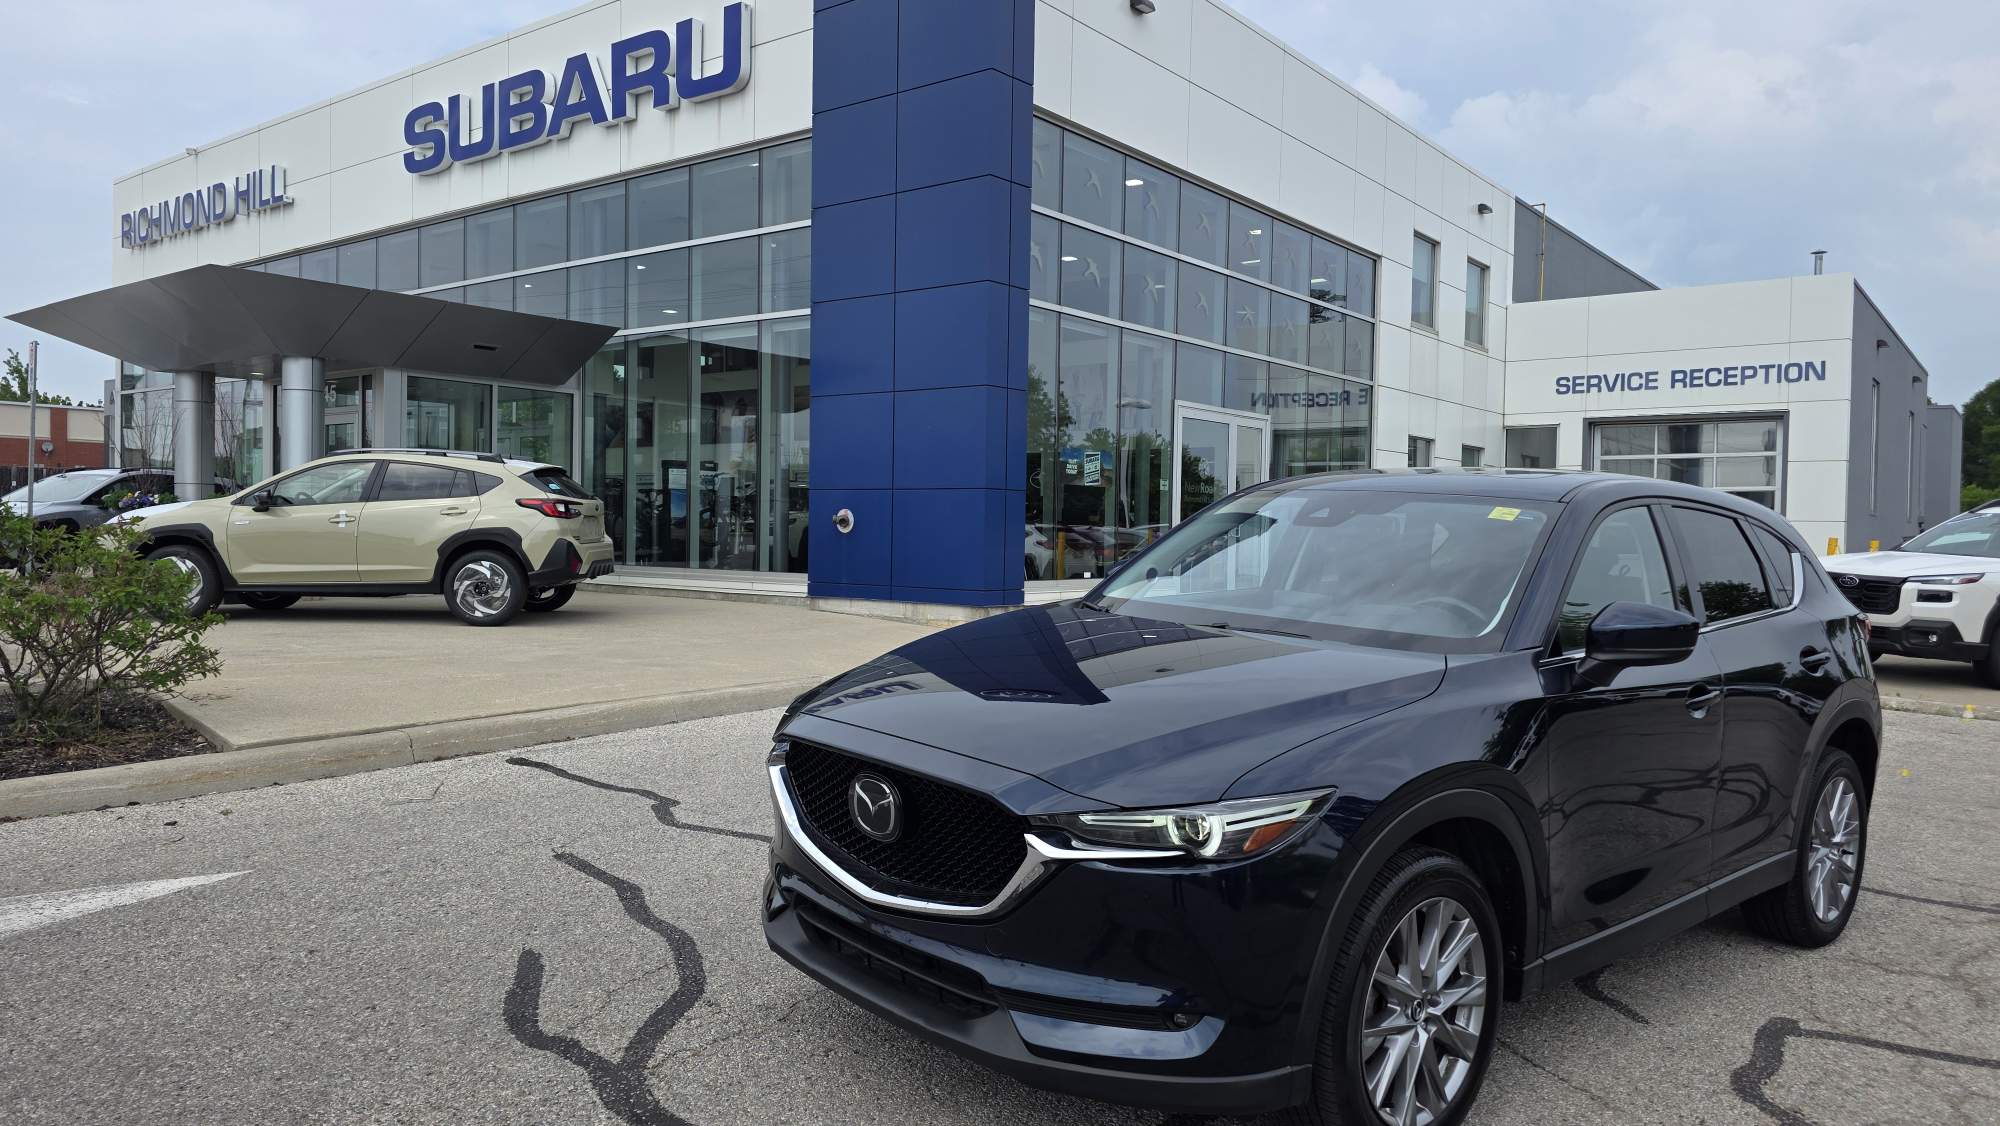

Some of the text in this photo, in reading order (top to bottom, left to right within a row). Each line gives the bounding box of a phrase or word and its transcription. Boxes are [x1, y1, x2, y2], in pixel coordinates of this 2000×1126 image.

[403, 1, 746, 175] SUBARU
[121, 165, 285, 248] RICHMOND HILL
[1555, 360, 1826, 395] SERVICE RECEPTION
